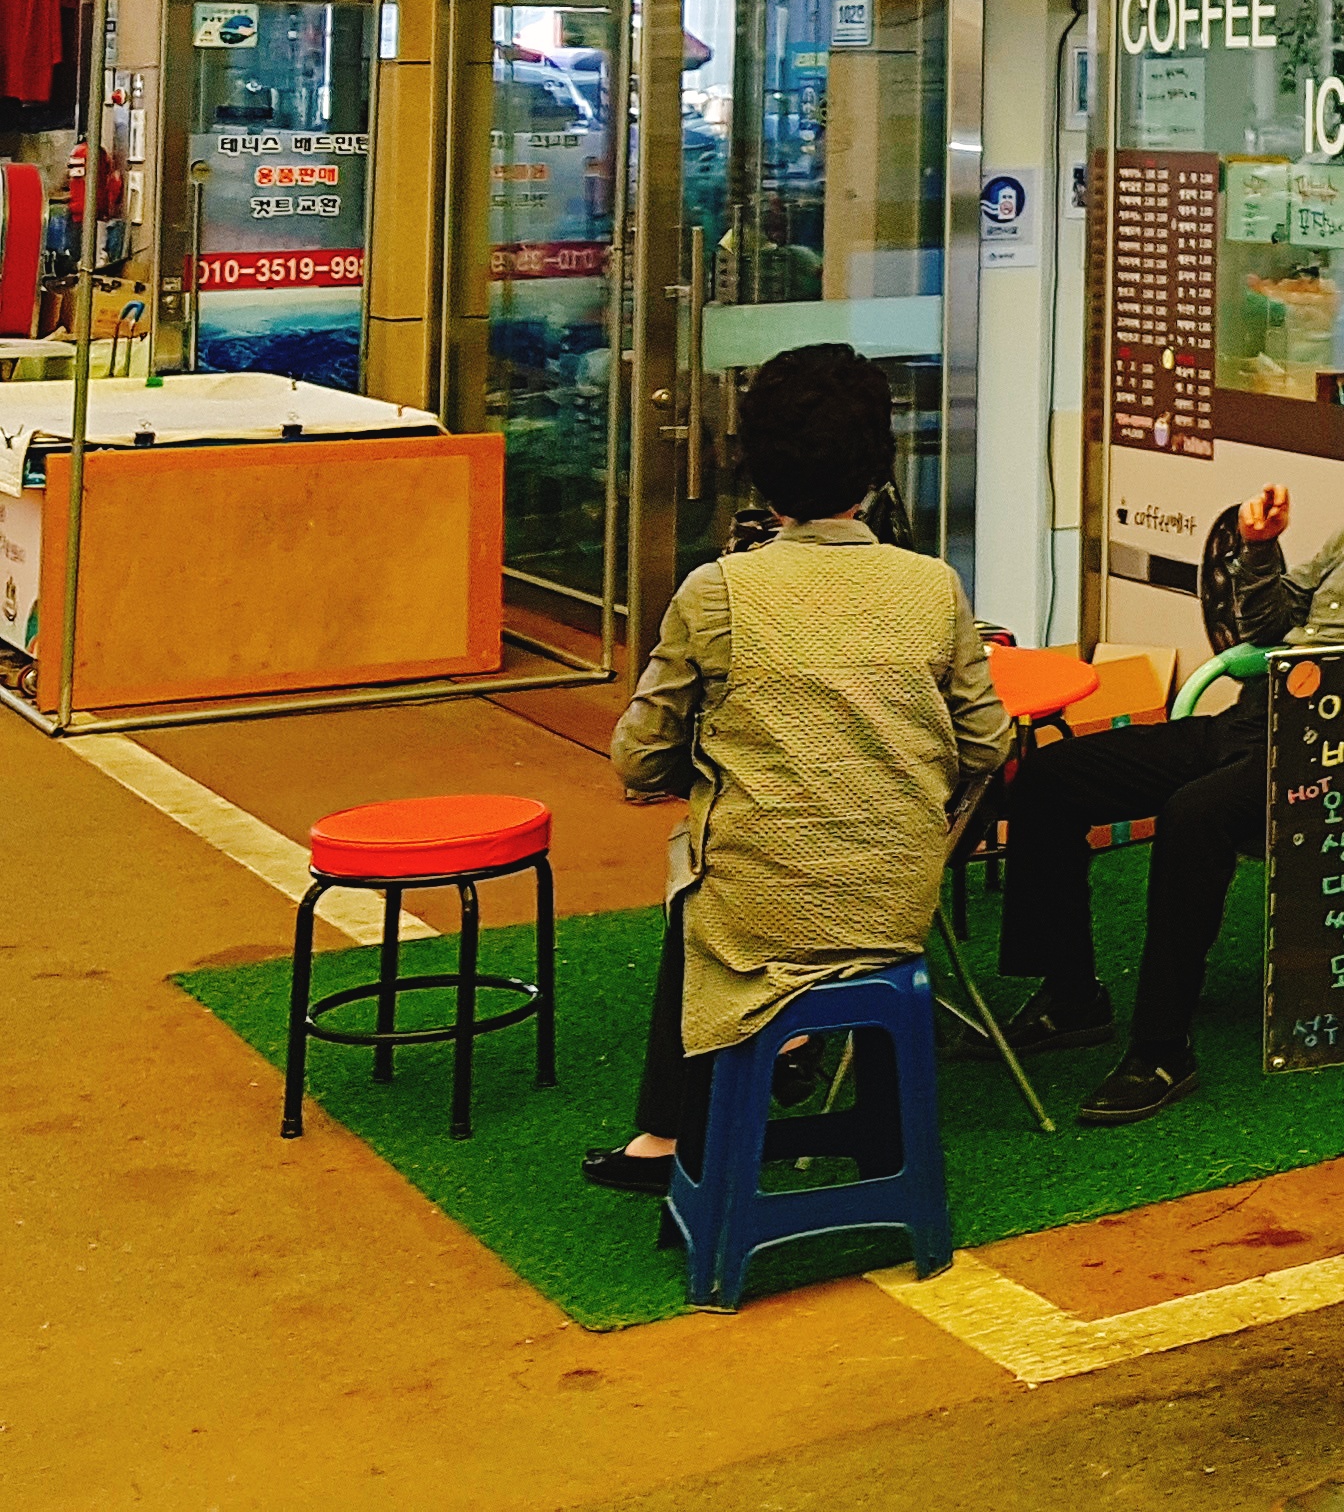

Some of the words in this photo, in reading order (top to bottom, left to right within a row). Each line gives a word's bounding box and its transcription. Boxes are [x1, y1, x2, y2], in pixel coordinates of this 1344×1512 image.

[220, 136, 280, 155] 테니스
[258, 167, 337, 185] 용품판매
[198, 256, 364, 284] 010-3519-99
[1288, 776, 1332, 805] HOT
